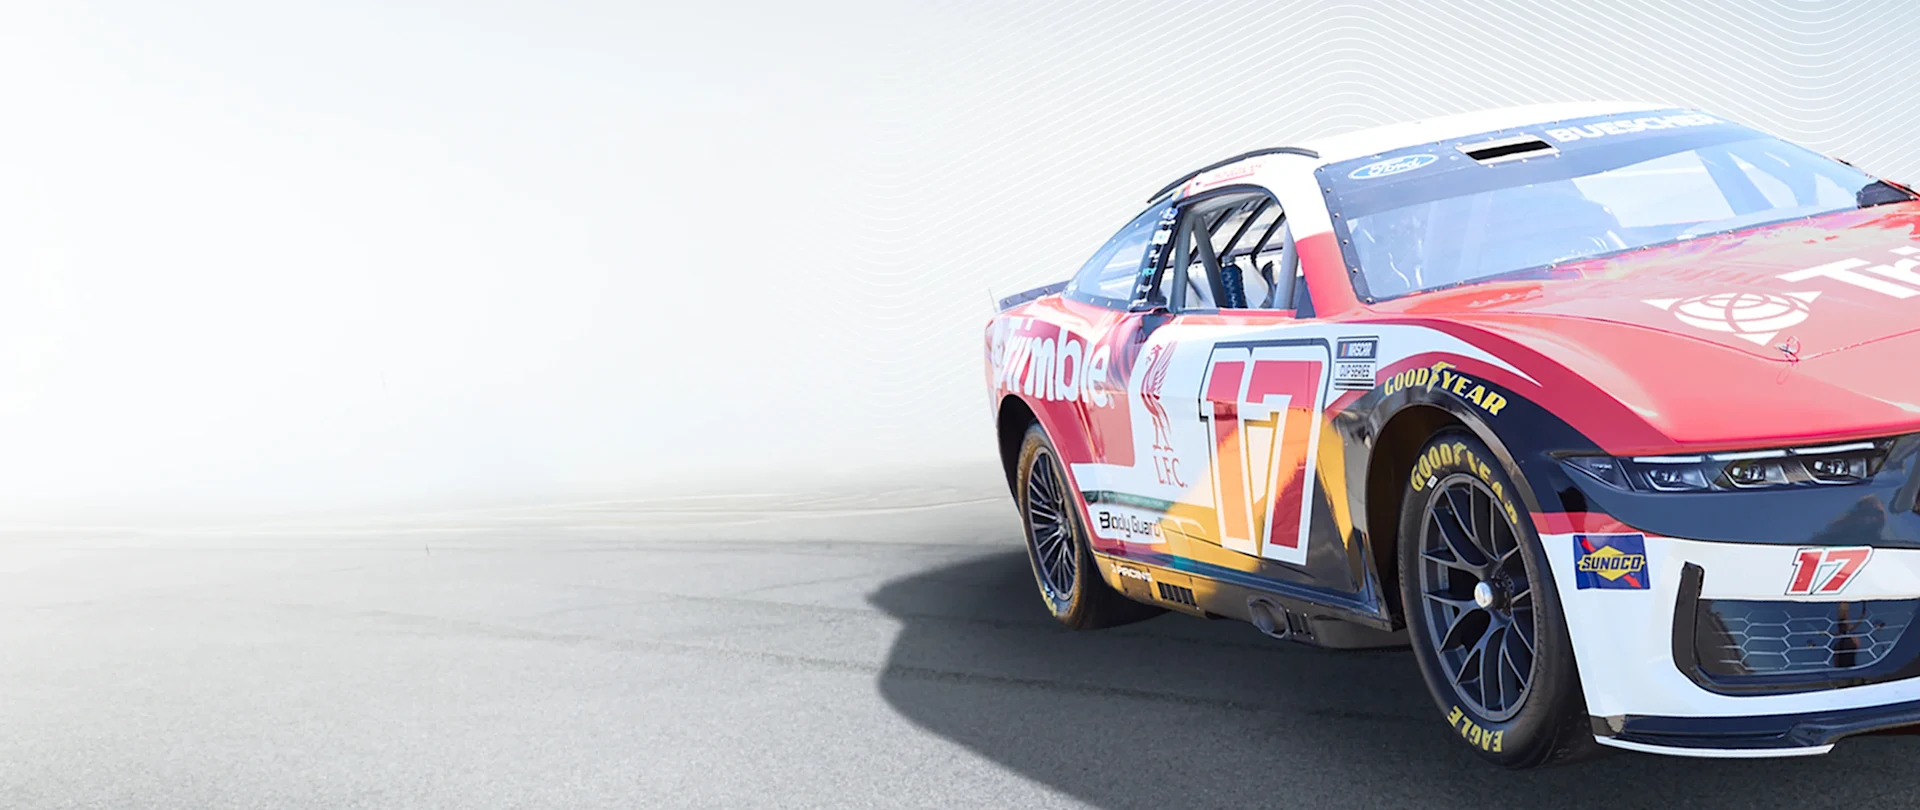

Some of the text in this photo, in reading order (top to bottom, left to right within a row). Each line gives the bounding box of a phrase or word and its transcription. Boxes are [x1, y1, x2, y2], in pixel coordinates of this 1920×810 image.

[1545, 114, 1725, 142] BUESCHER
[1367, 157, 1419, 176] Ford
[996, 317, 1111, 408] Trimble
[1203, 352, 1326, 557] 17
[1581, 555, 1642, 570] SUNOCO
[1787, 548, 1872, 594] 17
[1447, 705, 1504, 752] EAGLE
